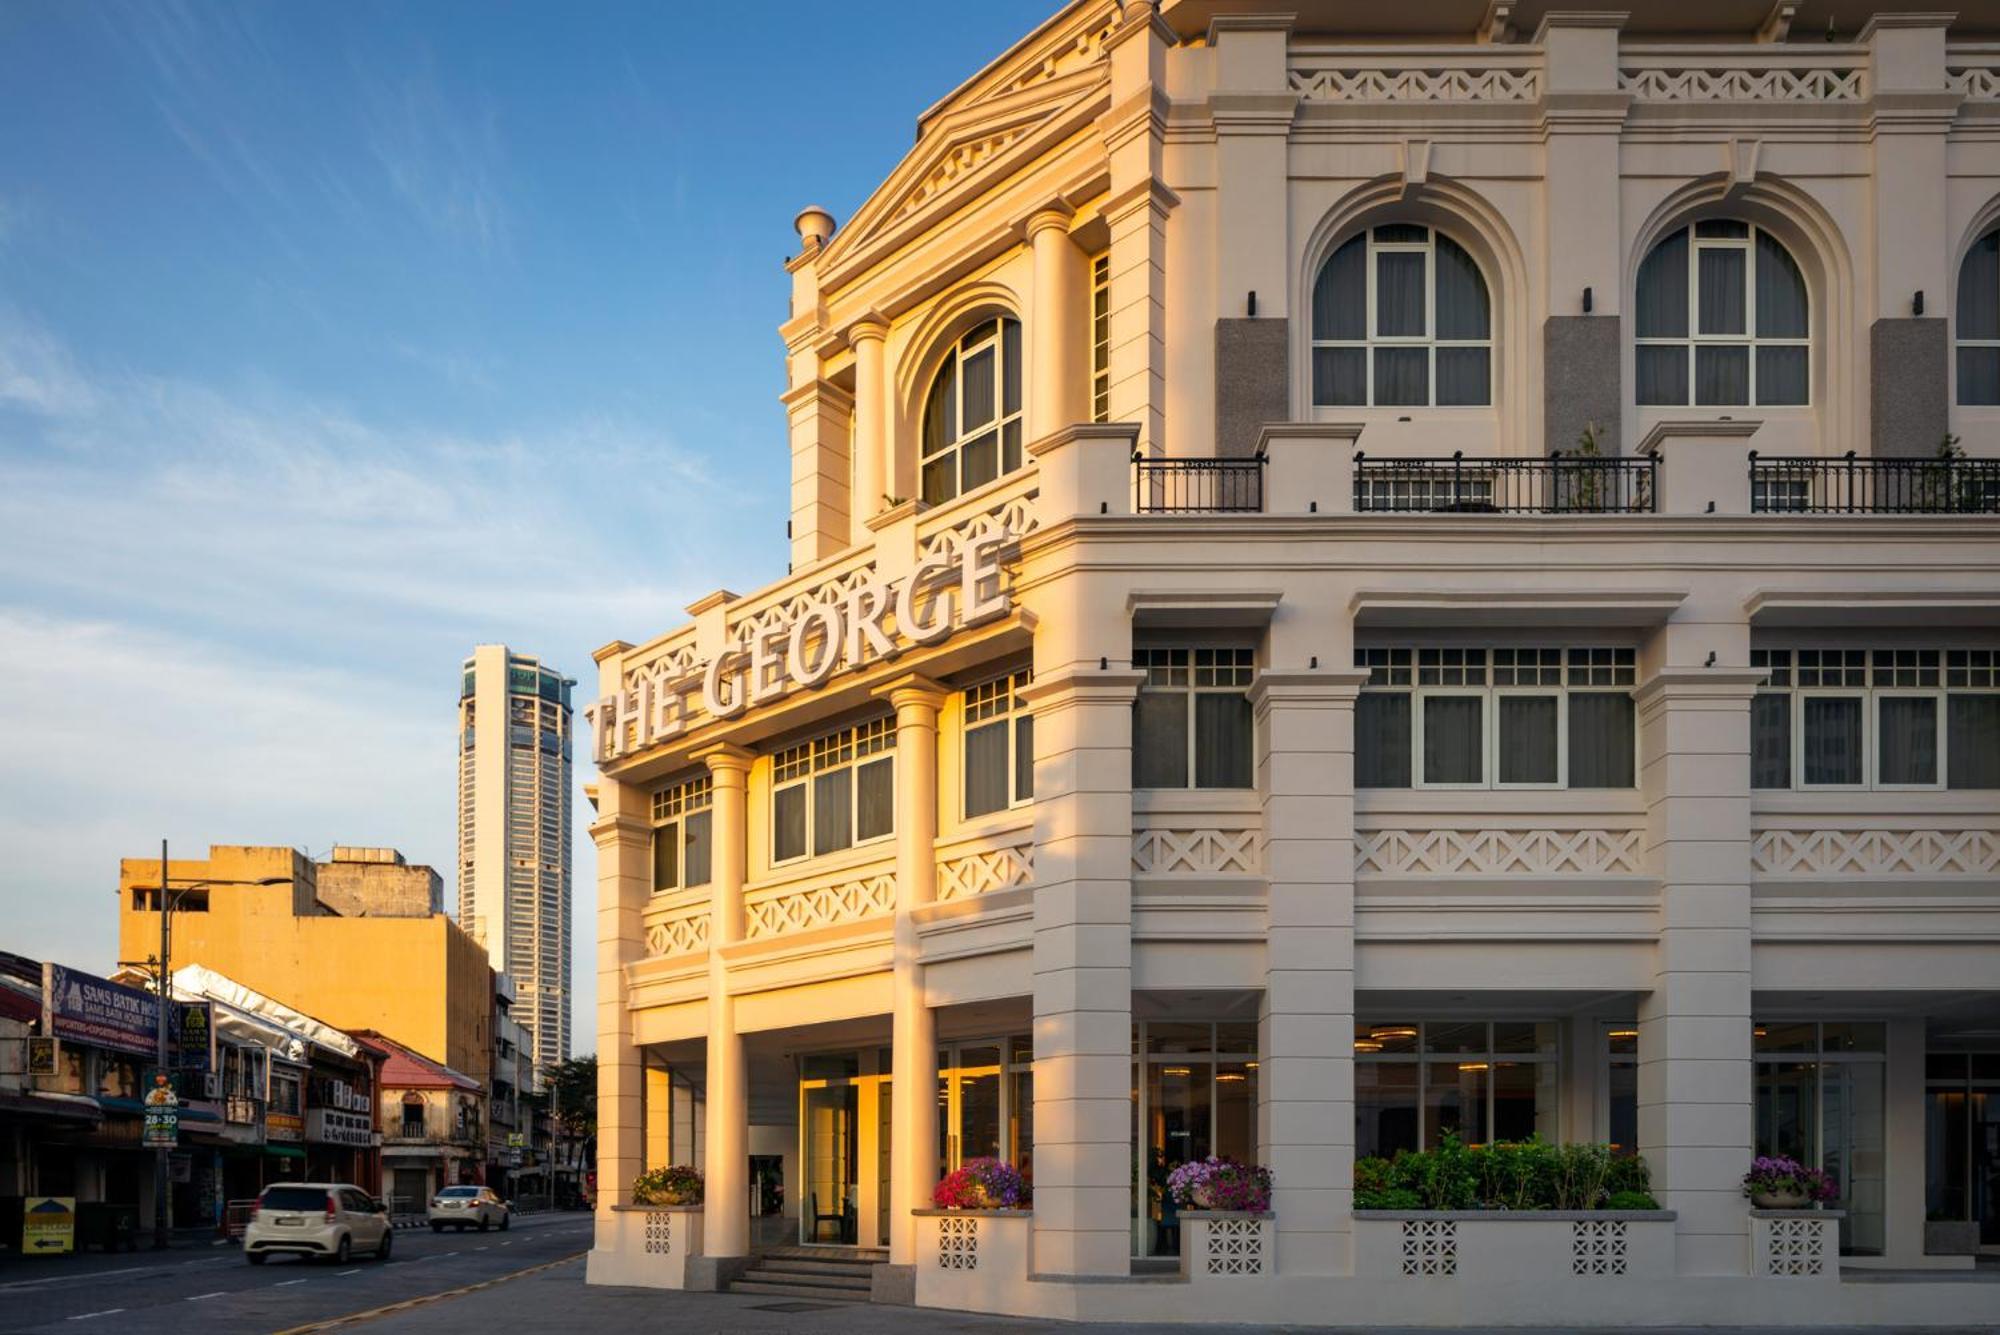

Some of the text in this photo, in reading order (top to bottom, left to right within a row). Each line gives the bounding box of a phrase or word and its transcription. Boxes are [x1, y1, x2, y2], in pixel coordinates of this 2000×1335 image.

[585, 525, 1011, 764] THE GEORGE
[82, 984, 112, 1006] SAMS
[113, 992, 140, 1014] BATIK
